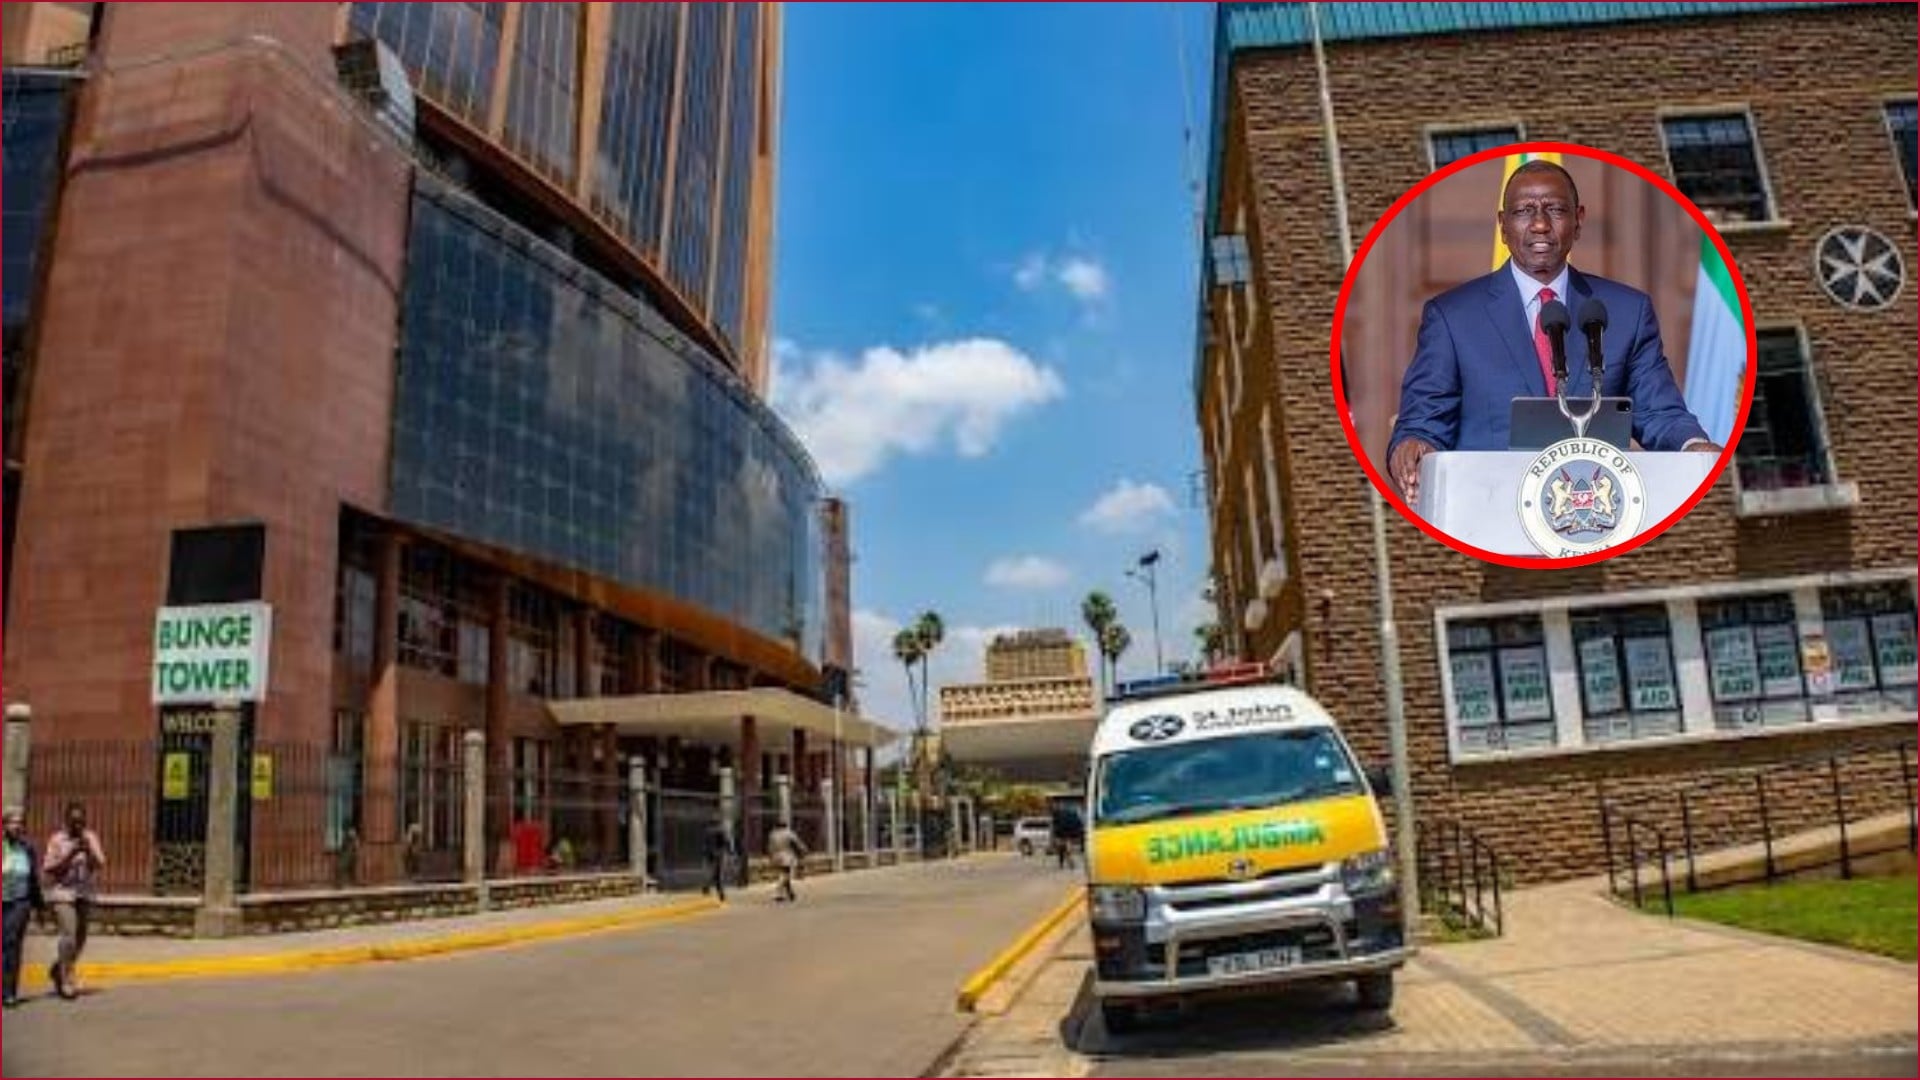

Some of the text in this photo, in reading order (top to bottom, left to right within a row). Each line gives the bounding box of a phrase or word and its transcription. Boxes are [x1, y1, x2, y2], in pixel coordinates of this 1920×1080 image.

[1531, 442, 1633, 478] REPUBLIC OF
[159, 616, 252, 650] BUNGE
[157, 658, 250, 694] TOWER
[1640, 690, 1670, 705] AID
